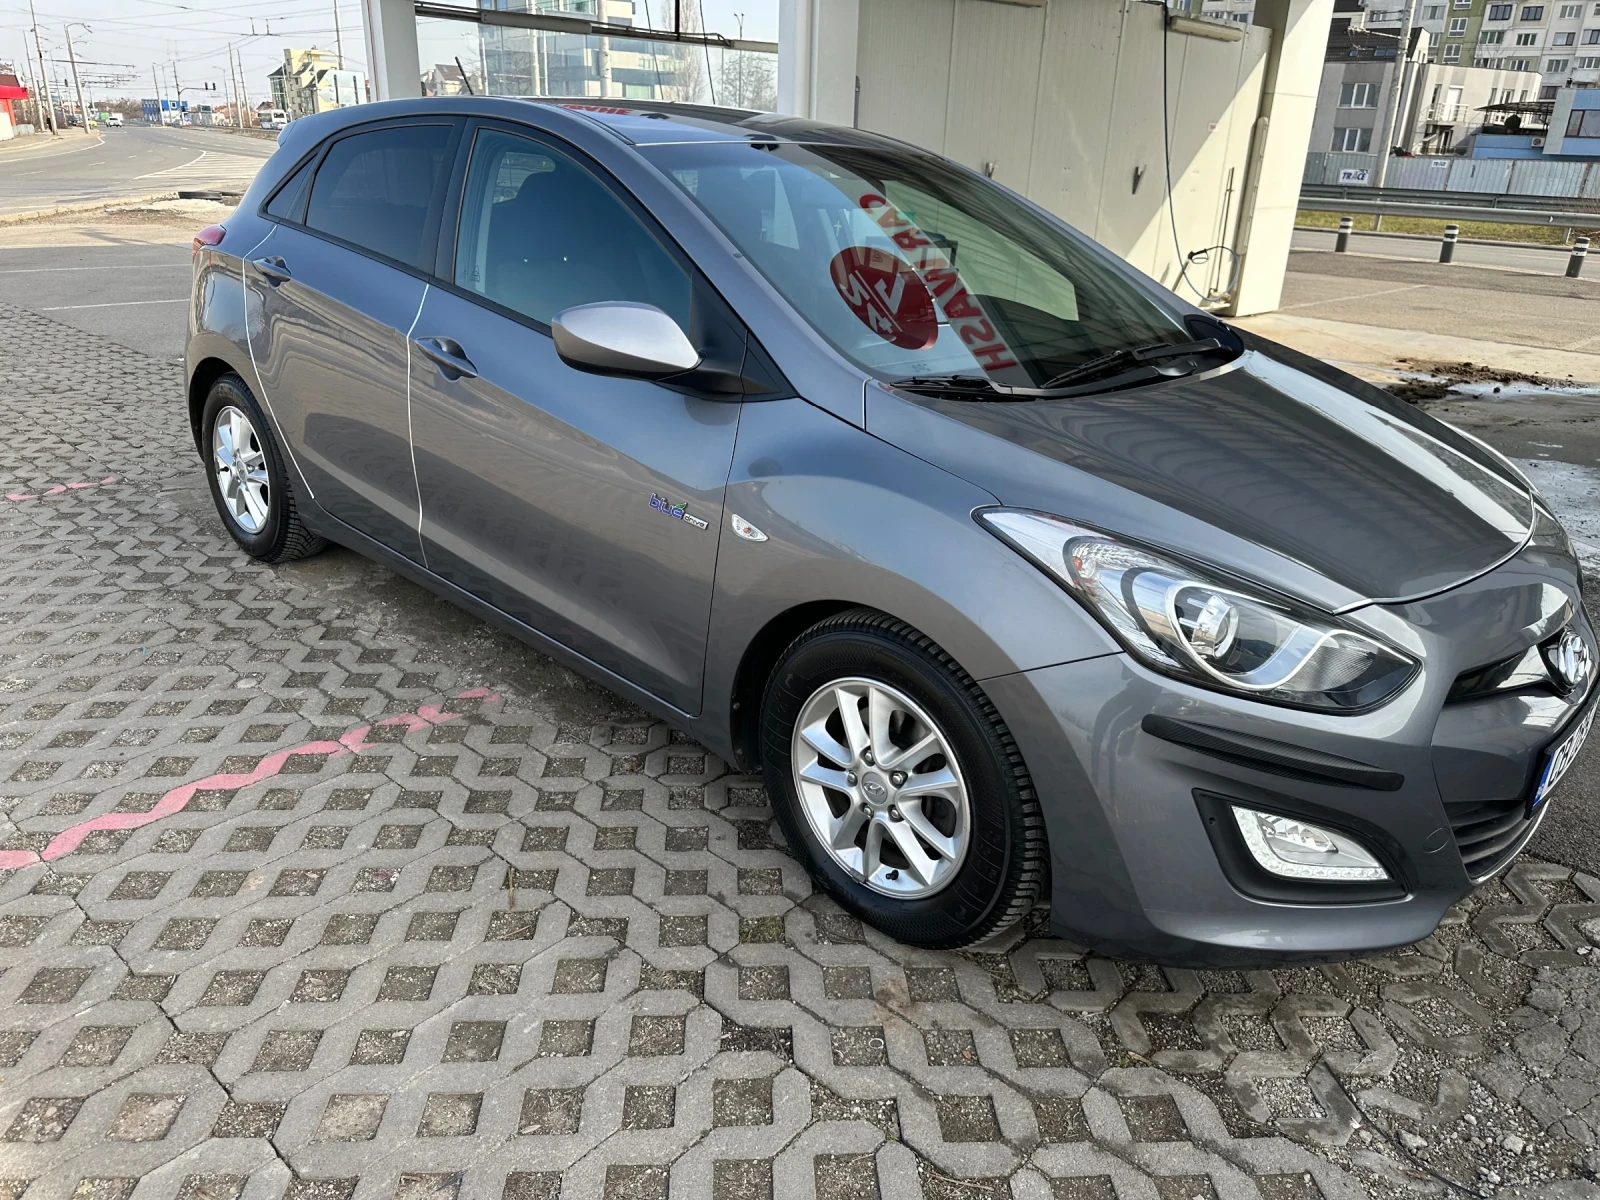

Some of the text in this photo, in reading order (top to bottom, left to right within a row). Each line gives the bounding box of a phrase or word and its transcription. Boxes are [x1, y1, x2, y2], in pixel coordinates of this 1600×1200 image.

[1342, 171, 1366, 181] TRACE
[649, 493, 705, 528] blue drive
